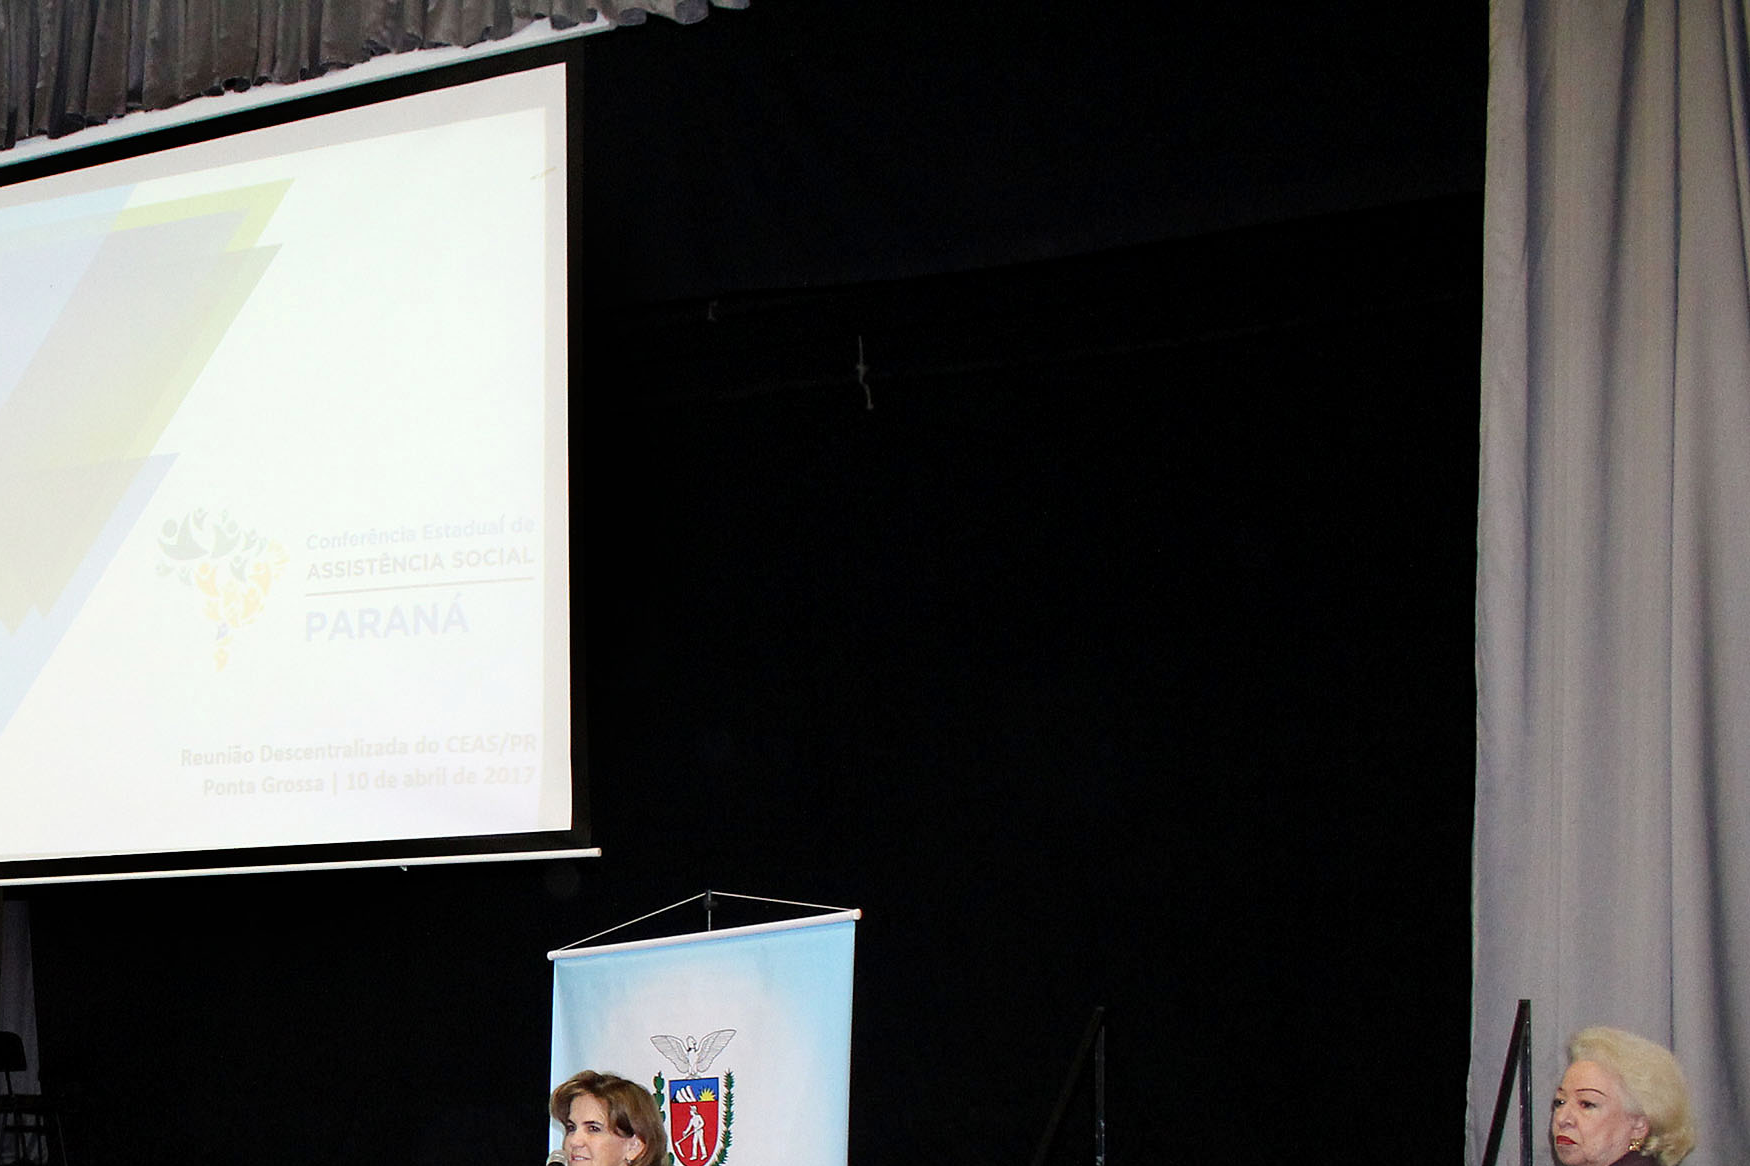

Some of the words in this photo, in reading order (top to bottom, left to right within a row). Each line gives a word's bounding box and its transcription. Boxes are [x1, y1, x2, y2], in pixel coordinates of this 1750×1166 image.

[306, 525, 416, 551] Conferência
[306, 551, 444, 581] ASSISTÊNCIA
[451, 547, 535, 570] SOCIAL
[305, 592, 470, 642] PARANÁ
[180, 744, 254, 767] Reunião
[260, 737, 409, 764] Descentralizada
[415, 735, 440, 755] do
[445, 733, 536, 756] CEAS/PR
[202, 776, 256, 797] Ponta
[261, 774, 324, 795] Grossa
[346, 771, 369, 791] 10
[373, 769, 398, 790] de
[402, 766, 447, 788] abril
[452, 765, 477, 785] de
